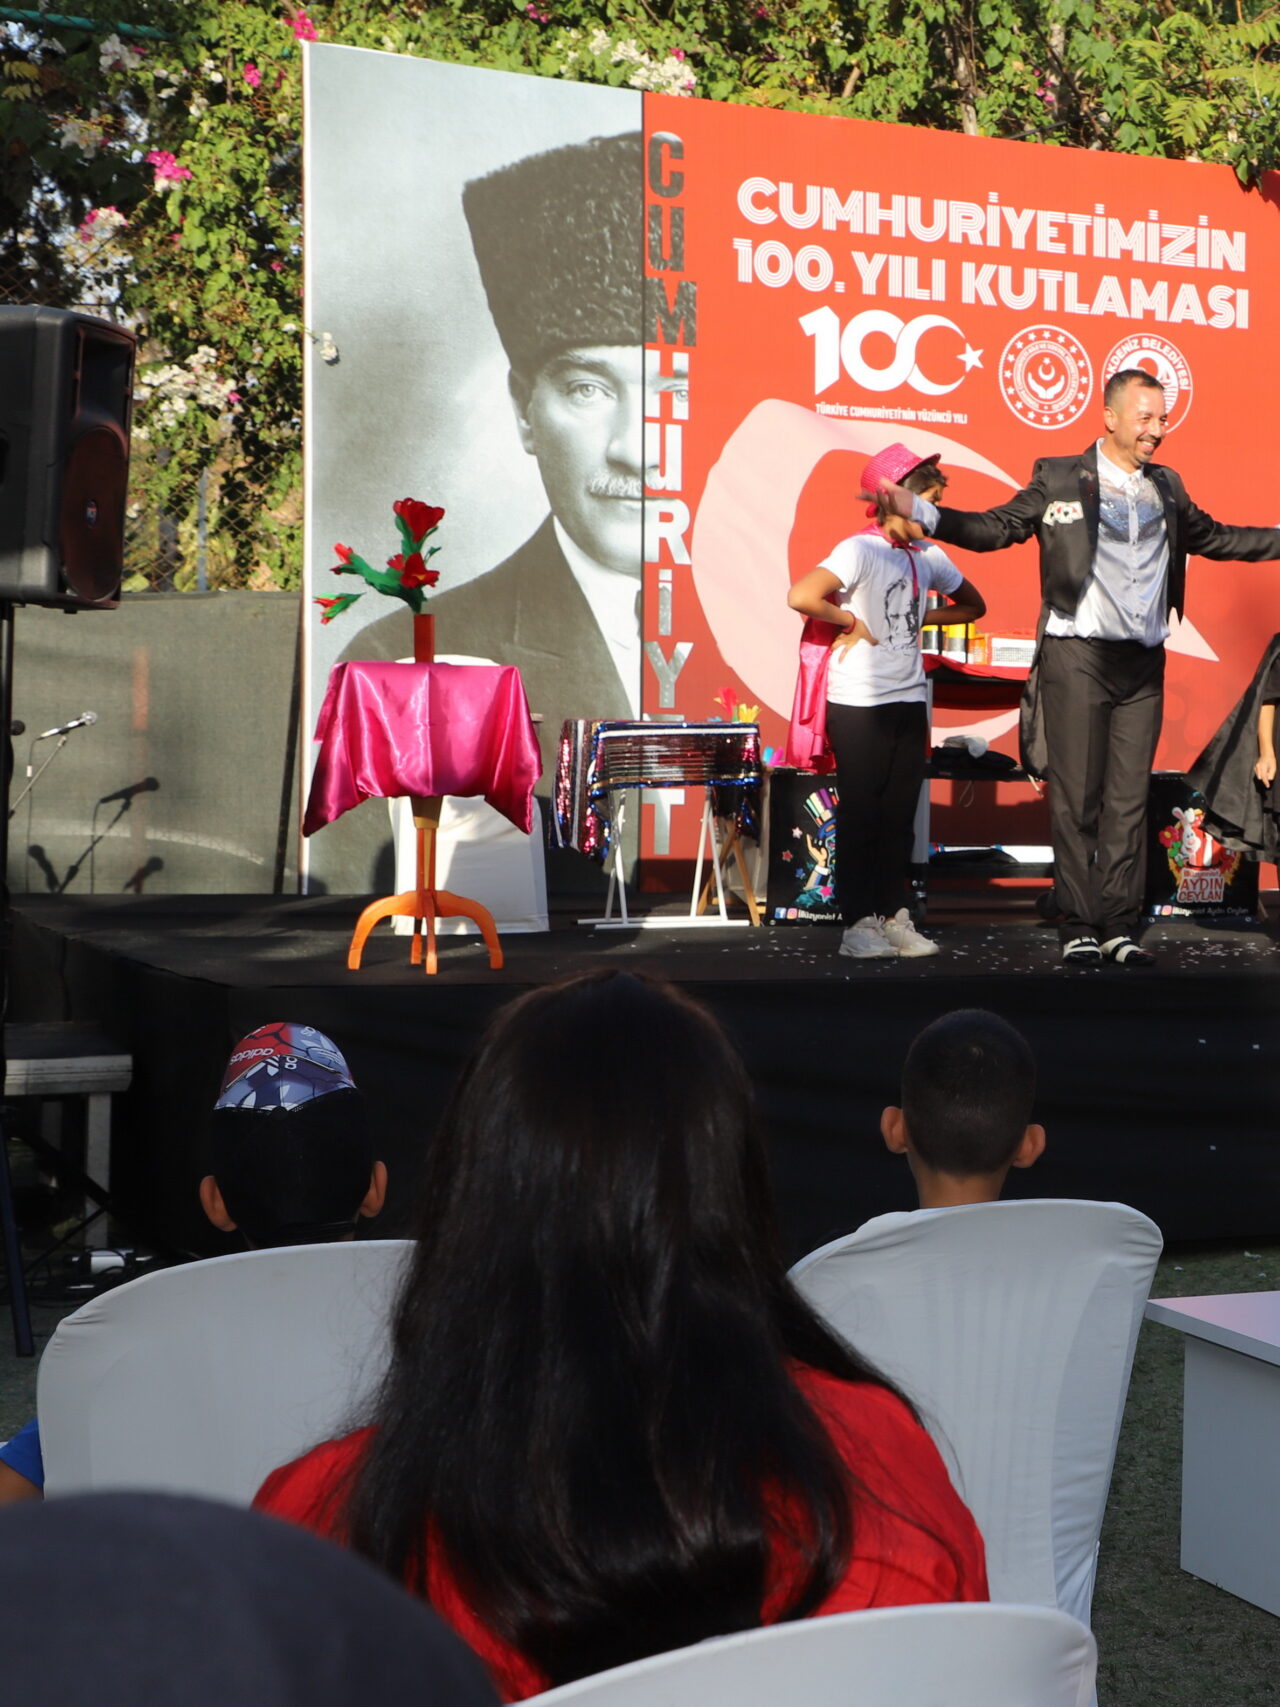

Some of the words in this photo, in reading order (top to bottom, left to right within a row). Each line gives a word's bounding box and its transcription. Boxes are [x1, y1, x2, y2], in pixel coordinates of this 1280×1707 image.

[737, 177, 1246, 272] CUMHURİYETİMİZİN
[733, 238, 845, 293] 100.
[851, 251, 946, 301] YILI
[961, 261, 1249, 330] KUTLAMASI
[1141, 337, 1192, 390] BELEDİYESİ
[815, 401, 849, 416] TÜRKİYE
[917, 409, 952, 423] YÜZÜNCÜ
[952, 412, 968, 424] YILI
[644, 131, 697, 855] CUMHURİYT
[1178, 891, 1222, 901] CEYLAN
[1181, 878, 1223, 891] AYDIN
[230, 1048, 274, 1065] adidas
